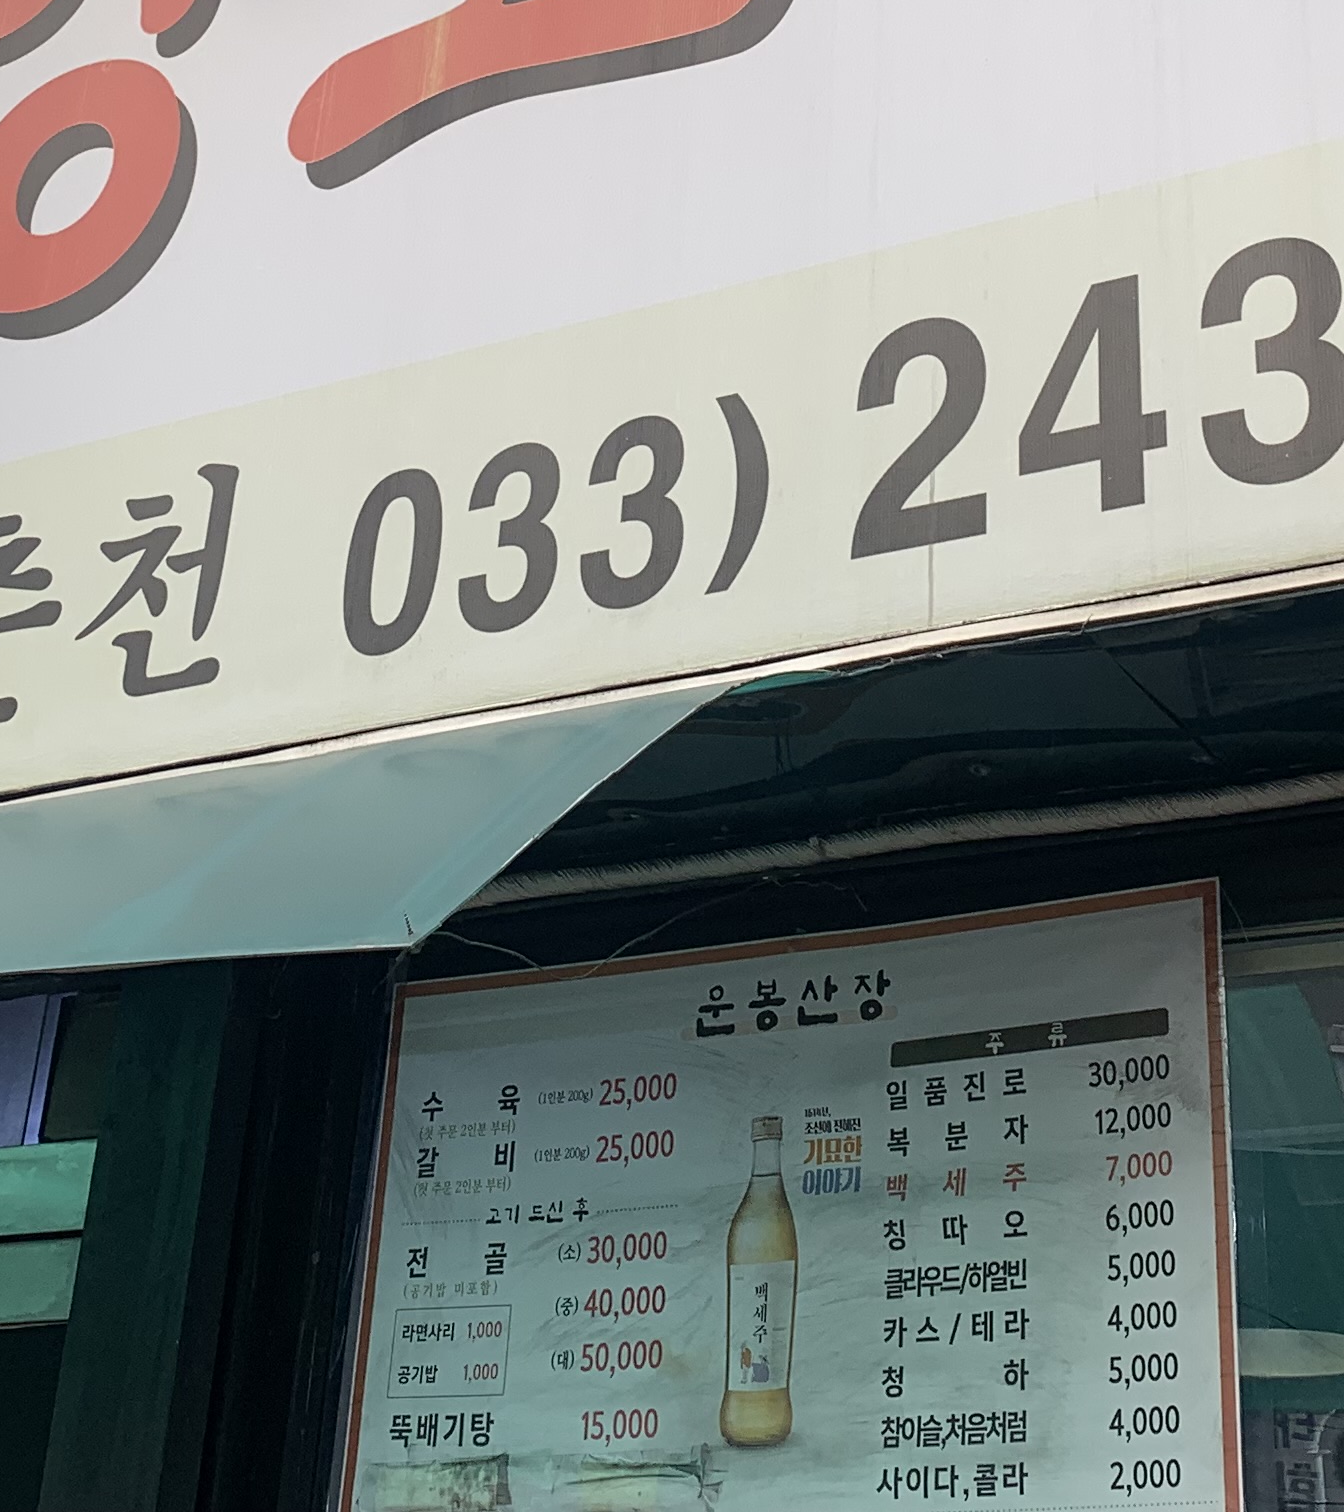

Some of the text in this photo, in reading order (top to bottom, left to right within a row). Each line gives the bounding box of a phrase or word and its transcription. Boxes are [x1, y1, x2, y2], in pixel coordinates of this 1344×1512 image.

[342, 393, 769, 656] 033)
[696, 969, 891, 1037] 운봉산장
[1088, 1054, 1169, 1091] 30,000
[598, 1073, 677, 1111] 25,000
[1094, 1102, 1171, 1139] 12,000
[595, 1129, 674, 1168] 25,000
[803, 1135, 862, 1165] 기묘한
[802, 1166, 861, 1195] 이야기
[1106, 1150, 1172, 1187] 7,000
[485, 1197, 590, 1225] 고기 드신 후
[1106, 1199, 1174, 1237] 6,000
[558, 1241, 582, 1263] (소)
[587, 1231, 667, 1269] 30,000
[1107, 1249, 1176, 1287] 5,000
[555, 1284, 666, 1323] (중) 40,000
[1107, 1300, 1177, 1338] 4,000
[401, 1321, 502, 1344] 라면사리 1,000
[397, 1363, 498, 1385] 공기밥 1,000
[551, 1339, 662, 1378] (대) 50,000
[1109, 1352, 1178, 1390] 5,000
[389, 1408, 658, 1448] 뚝배기탕 15,000
[1109, 1405, 1180, 1442] 4,000
[1110, 1458, 1181, 1496] 2,000
